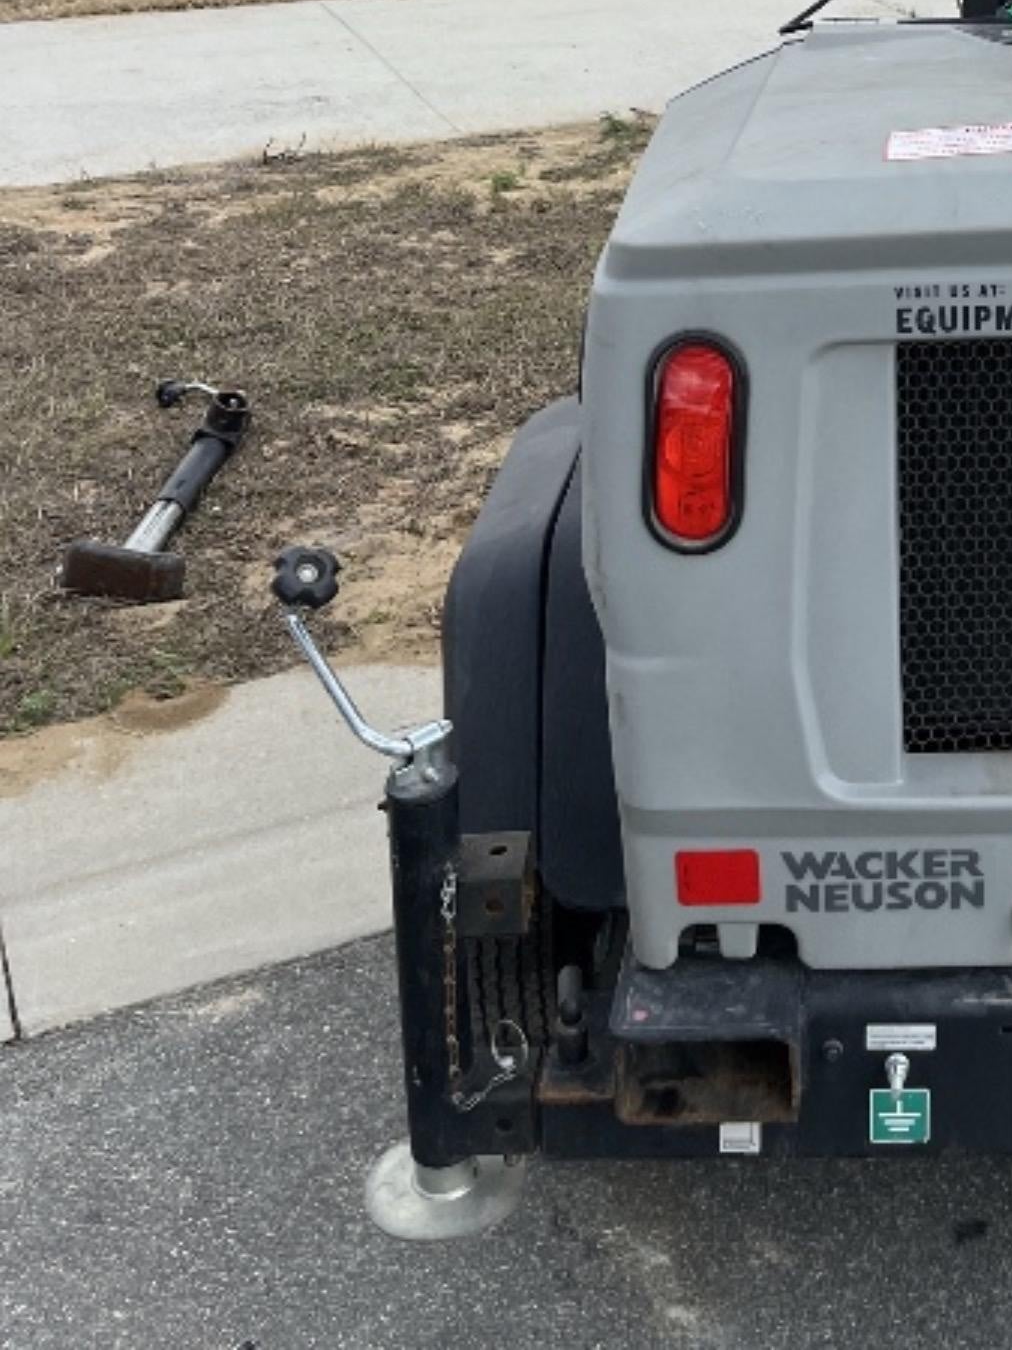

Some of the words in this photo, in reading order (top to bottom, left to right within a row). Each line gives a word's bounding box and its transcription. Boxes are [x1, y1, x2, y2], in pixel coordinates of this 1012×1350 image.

[949, 284, 970, 299] US
[780, 849, 985, 880] WACKER
[785, 881, 985, 912] NEUSON
